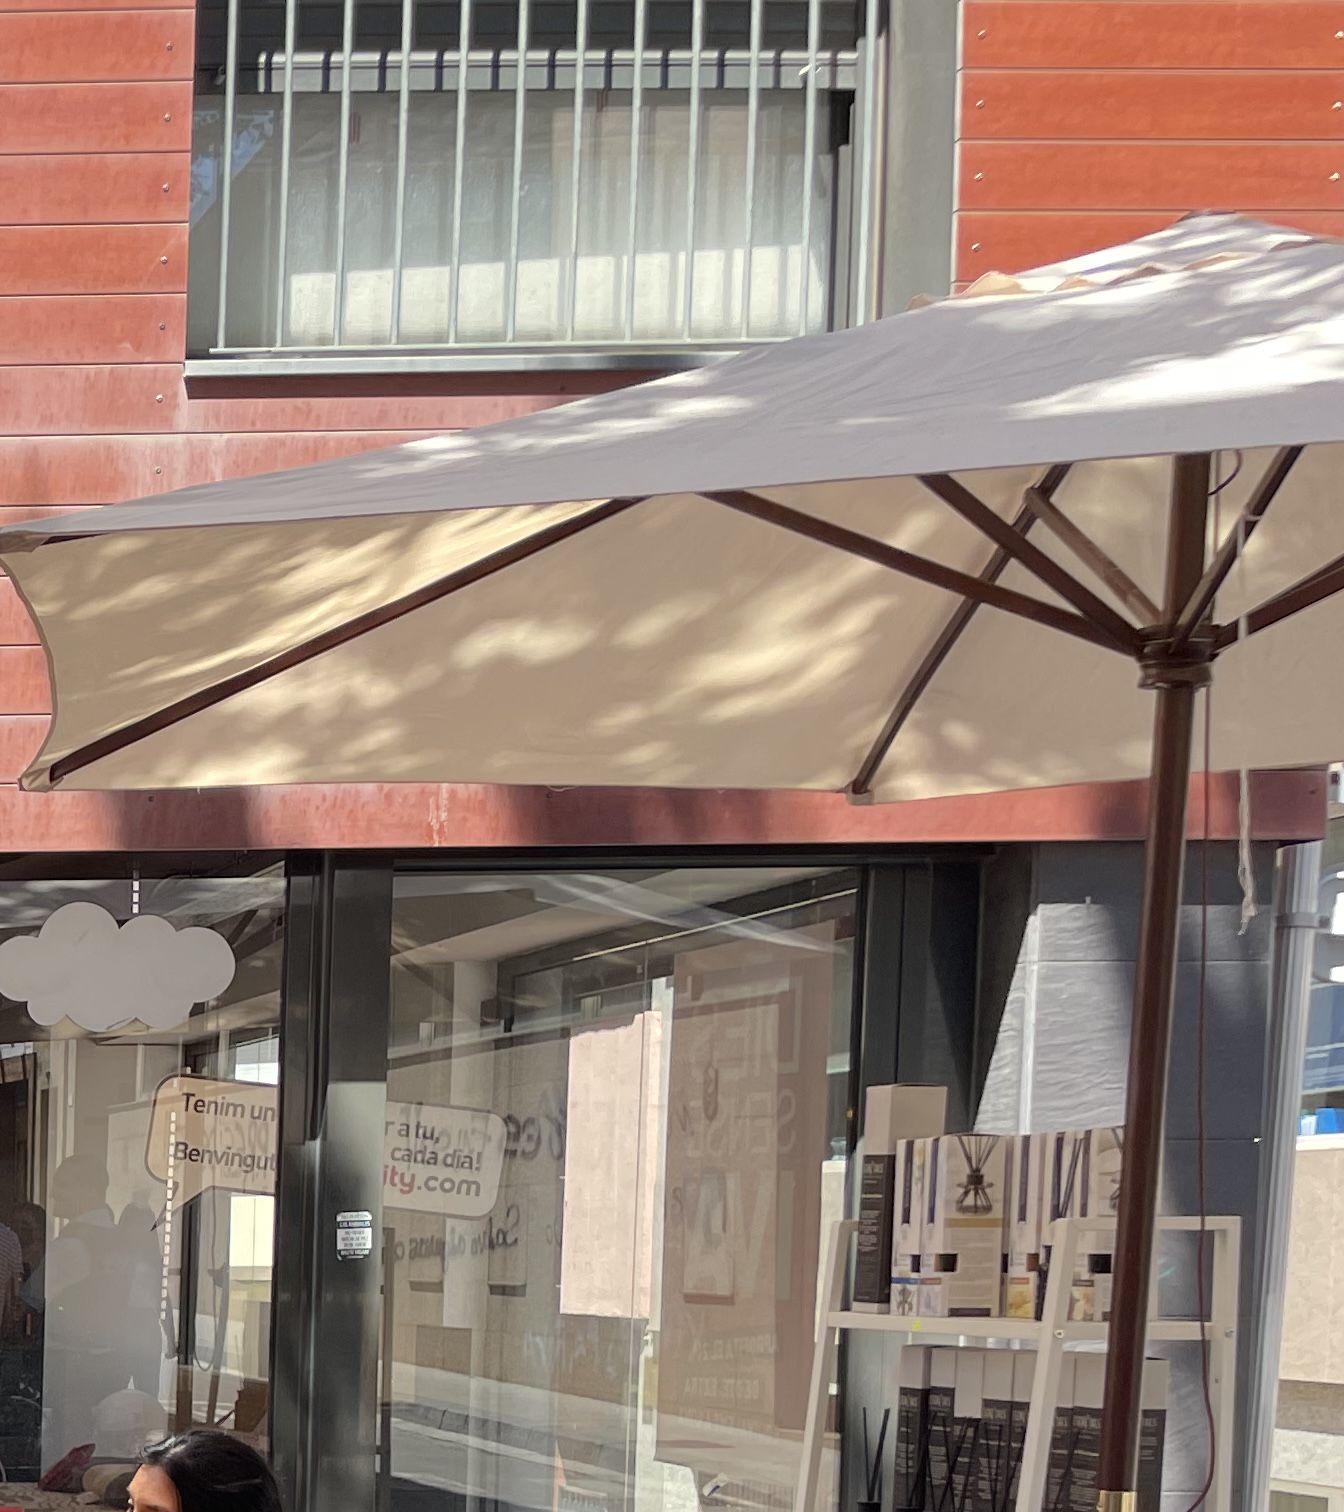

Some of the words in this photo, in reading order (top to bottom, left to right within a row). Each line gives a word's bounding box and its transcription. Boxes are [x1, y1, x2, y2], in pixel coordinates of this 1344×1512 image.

[182, 1093, 246, 1119] Tenim
[398, 1122, 410, 1138] a
[415, 1121, 440, 1144] tu,
[391, 1147, 438, 1166] cada
